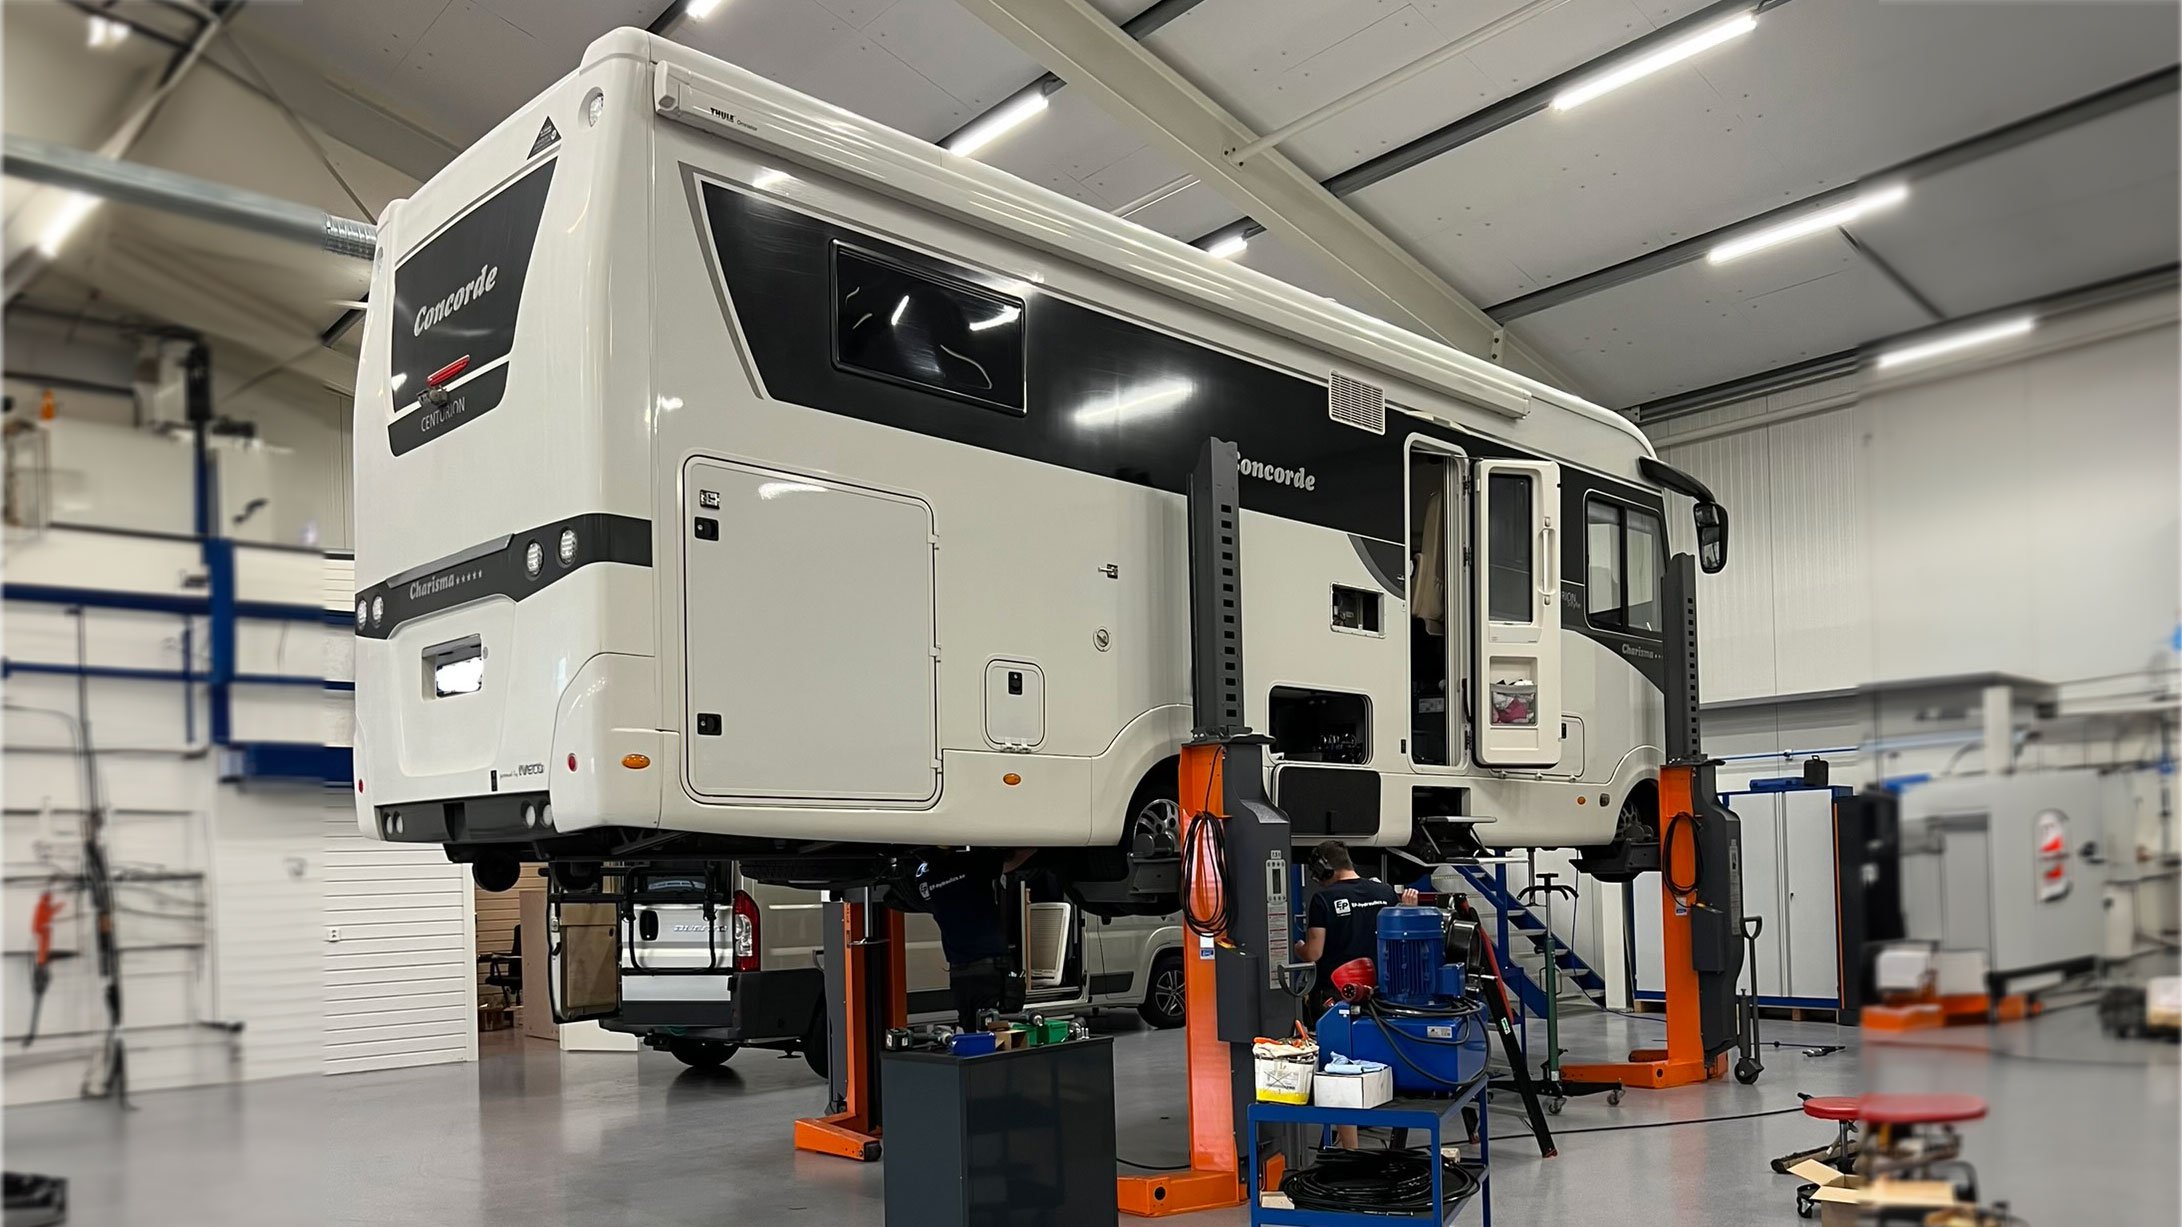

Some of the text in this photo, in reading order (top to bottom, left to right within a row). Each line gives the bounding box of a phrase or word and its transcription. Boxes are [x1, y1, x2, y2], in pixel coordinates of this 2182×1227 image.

[710, 107, 735, 123] THULE
[413, 264, 498, 337] Concorde
[421, 396, 466, 432] CENTURION
[1237, 451, 1316, 491] oncorde
[409, 573, 455, 600] Charisma
[1621, 643, 1654, 659] Charisma
